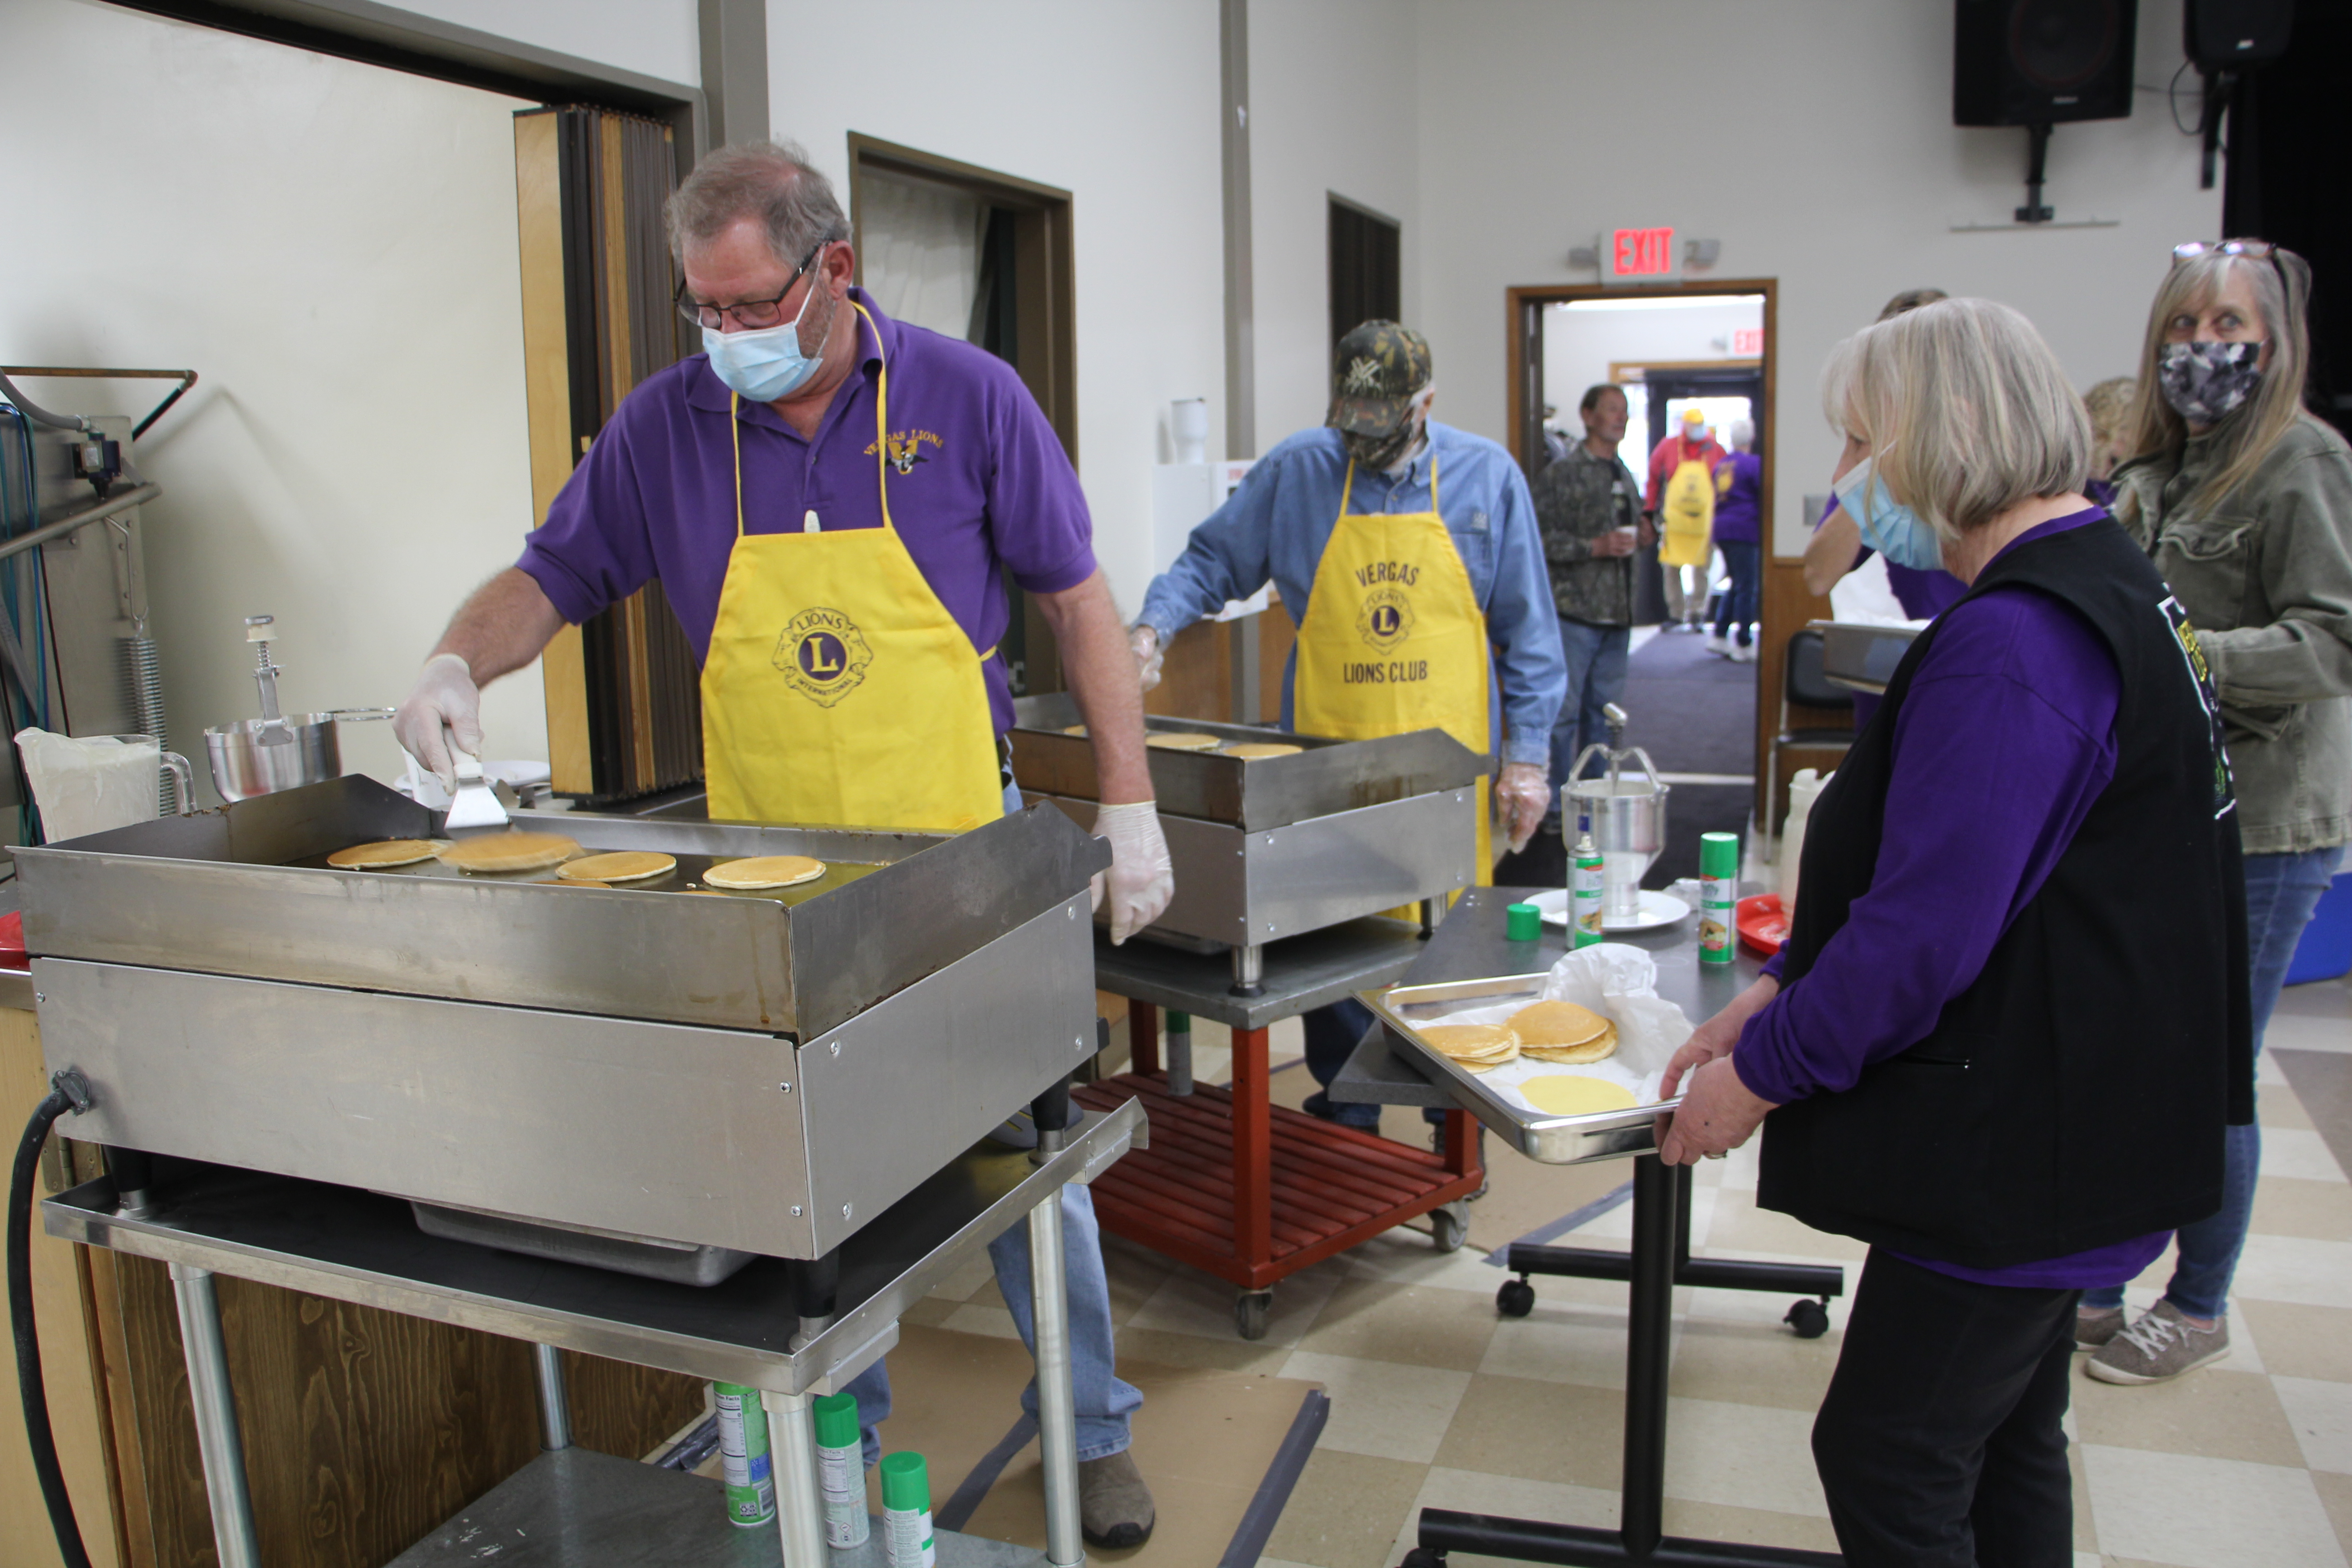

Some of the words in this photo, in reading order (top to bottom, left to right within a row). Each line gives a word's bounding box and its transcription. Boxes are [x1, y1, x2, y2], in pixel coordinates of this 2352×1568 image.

[1614, 227, 1674, 274] EXIT
[863, 431, 906, 455] VEGAS
[911, 429, 943, 448] LIONS
[1356, 561, 1420, 587] VERGAS
[797, 612, 843, 630] LIONS
[1378, 607, 1395, 632] L
[807, 637, 839, 672] L
[1343, 662, 1384, 684] LIONS
[1389, 660, 1427, 682] CLUB
